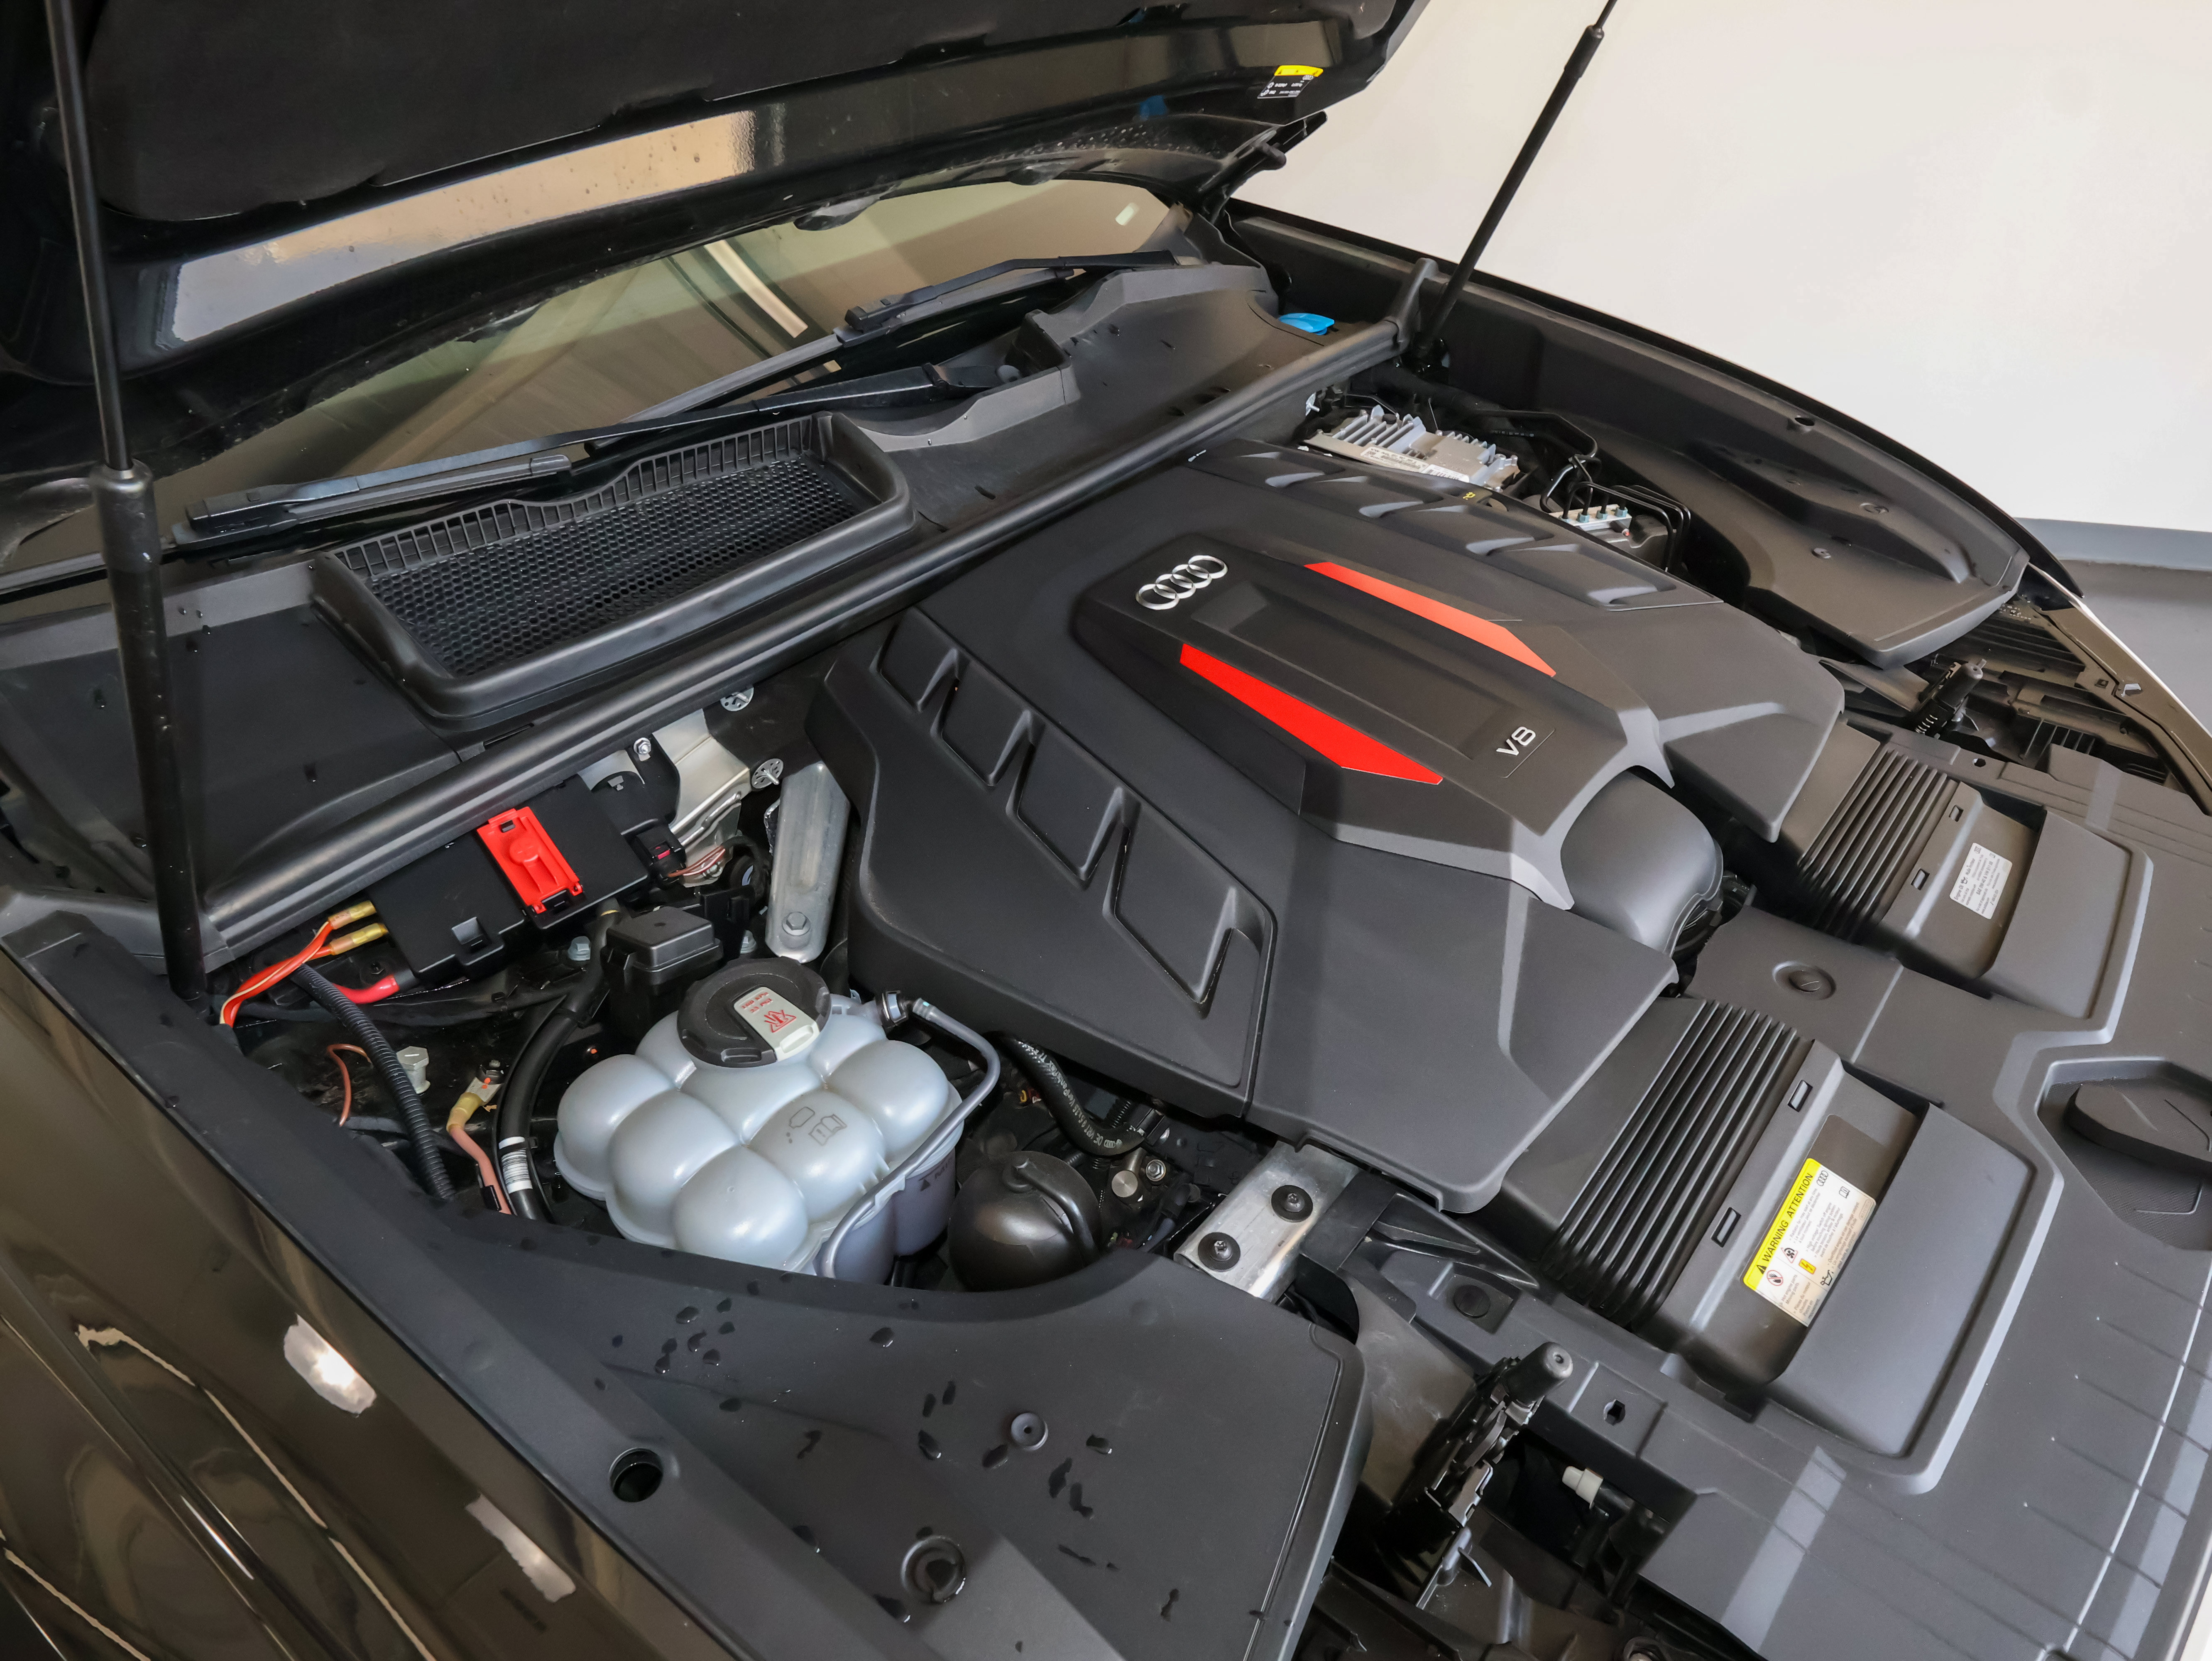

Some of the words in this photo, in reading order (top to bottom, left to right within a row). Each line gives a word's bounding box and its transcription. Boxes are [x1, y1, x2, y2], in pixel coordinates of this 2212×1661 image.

[1496, 726, 1536, 756] V8
[1762, 1220, 1788, 1261] WARNING
[1787, 1173, 1813, 1218] ATTENTION
[1789, 1224, 1798, 1237] Radiator
[1828, 1246, 1838, 1262] Overfilled
[1785, 1291, 1795, 1304] Moving
